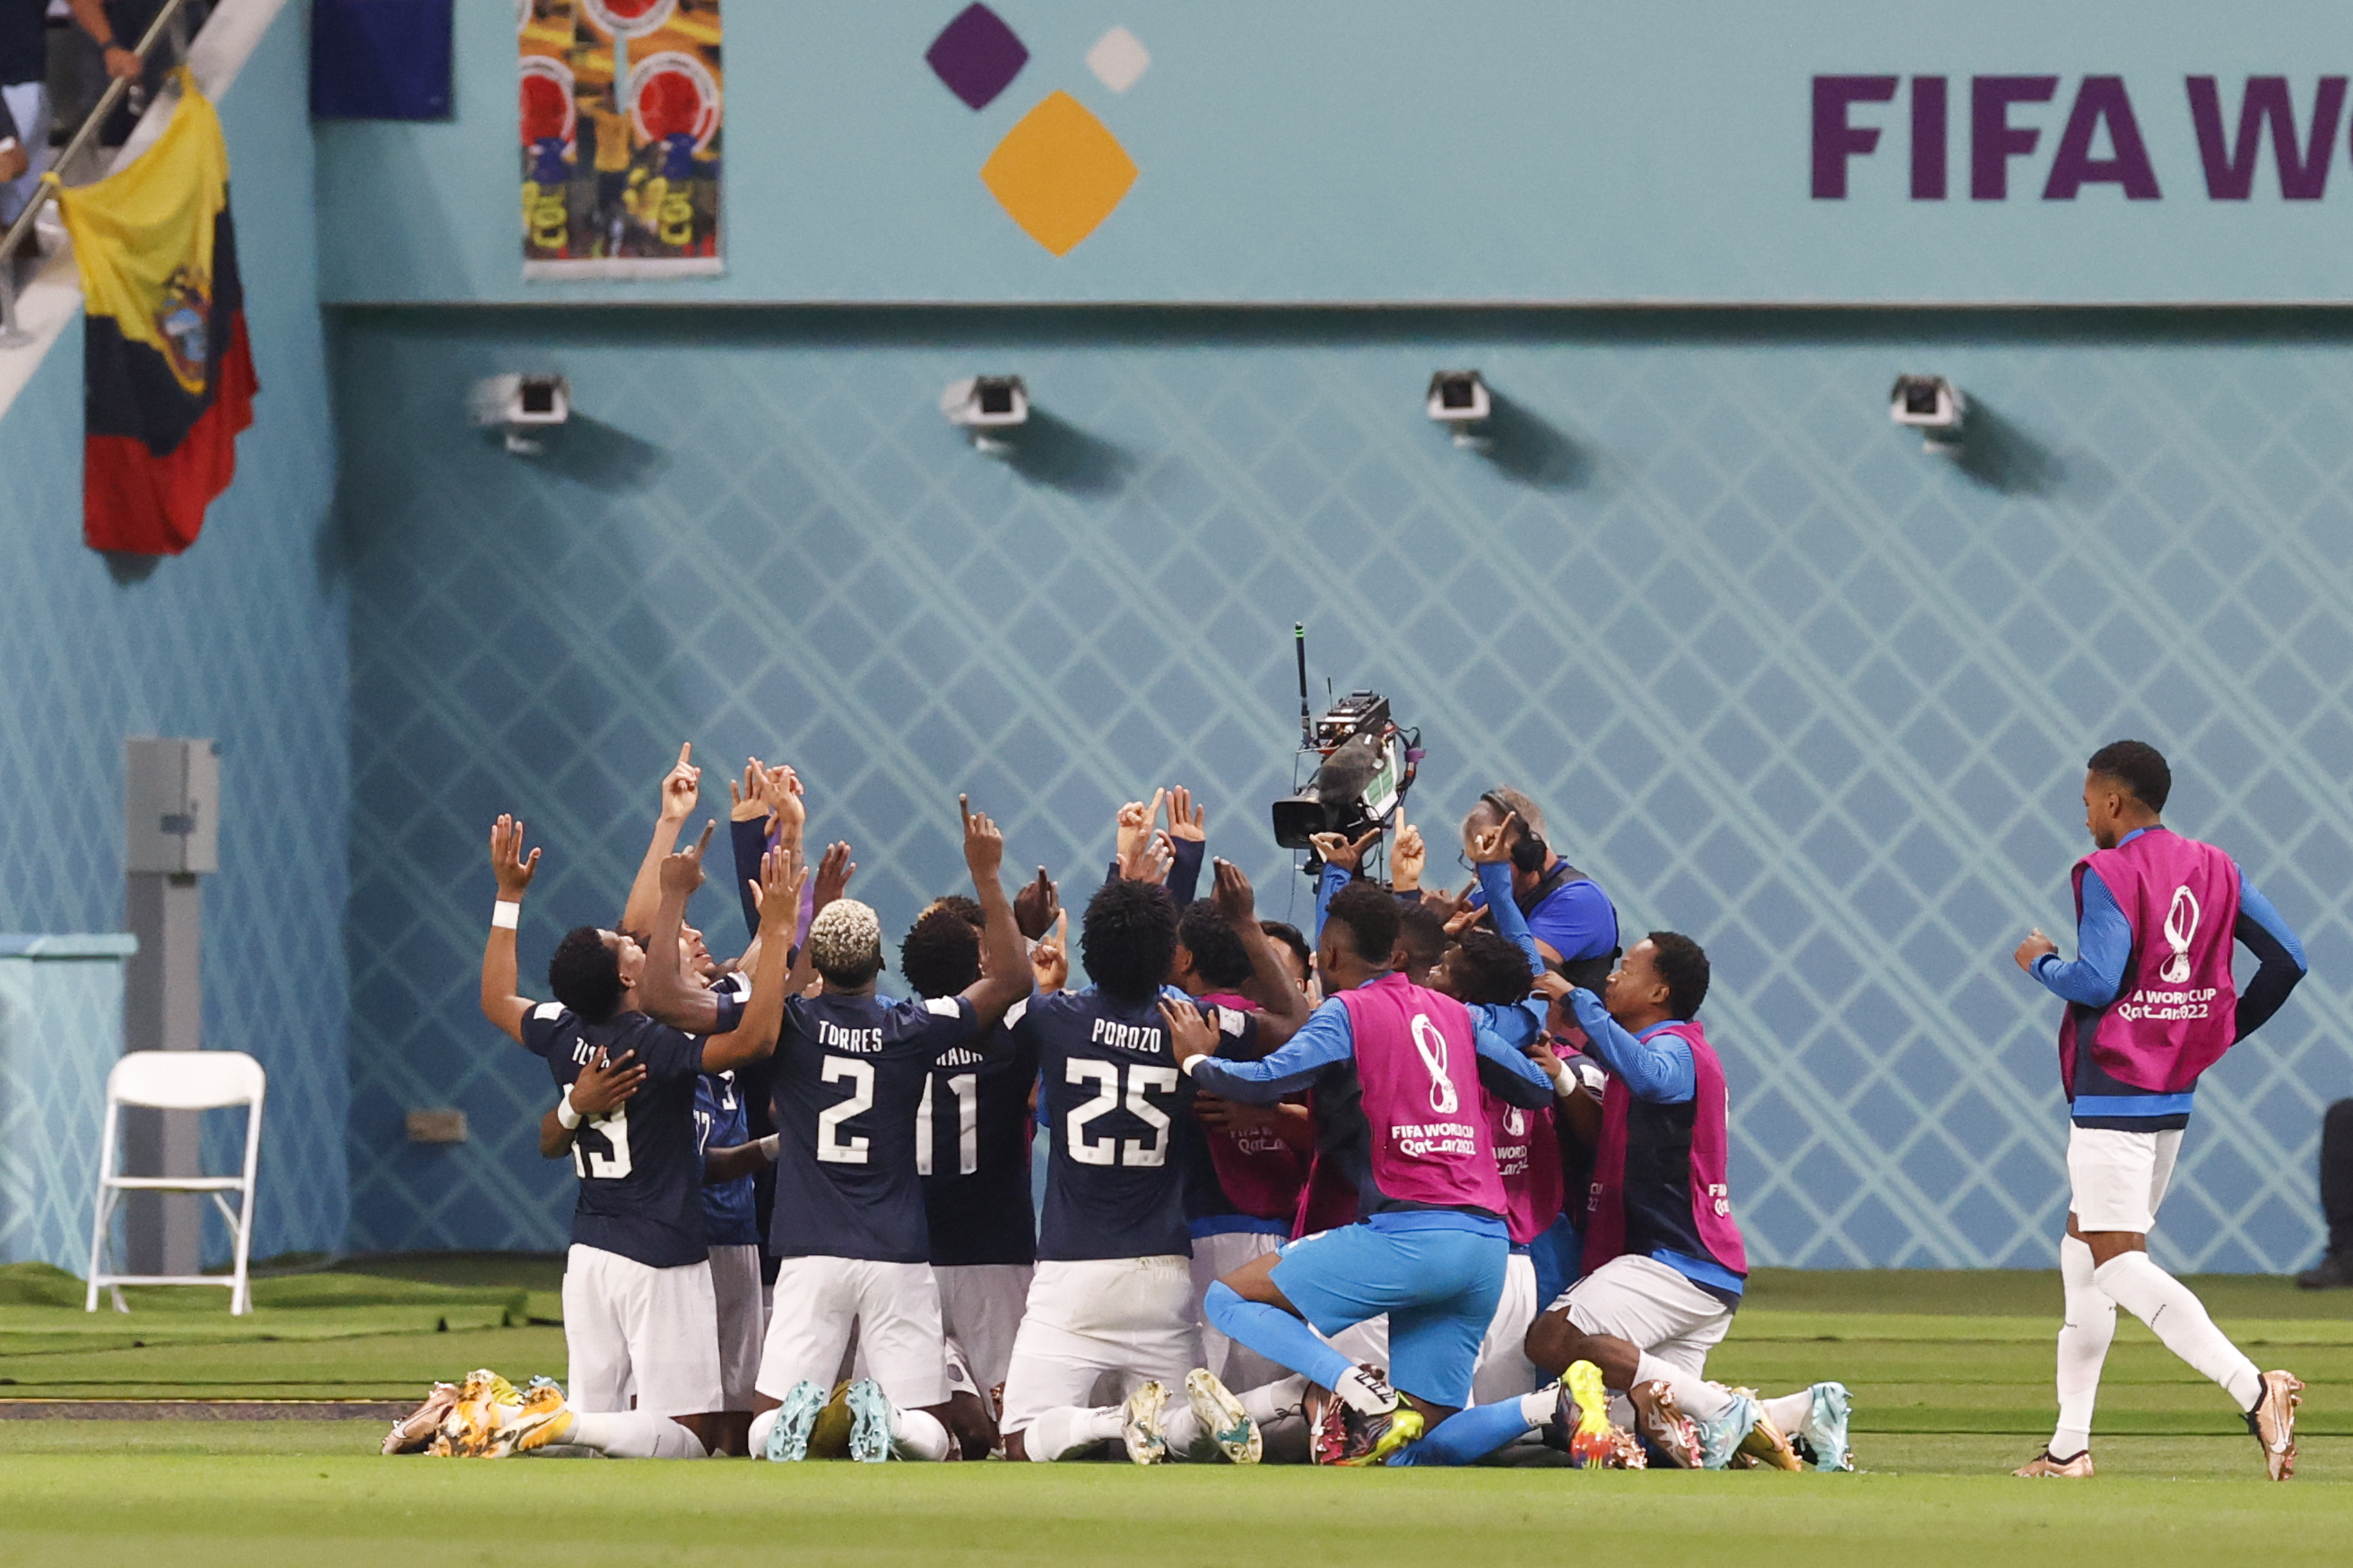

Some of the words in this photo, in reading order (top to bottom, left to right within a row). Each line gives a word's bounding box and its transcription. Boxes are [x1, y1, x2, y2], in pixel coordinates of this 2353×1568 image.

[1811, 74, 2161, 201] FIFA
[2185, 74, 2353, 201] W
[2188, 988, 2217, 1003] CUP
[817, 1020, 882, 1053] TORRES
[1091, 1018, 1161, 1053] POROZO
[817, 1054, 875, 1164] 2
[916, 1071, 977, 1175] 11
[1065, 1057, 1179, 1167] 25
[1391, 1125, 1423, 1139] FIFA
